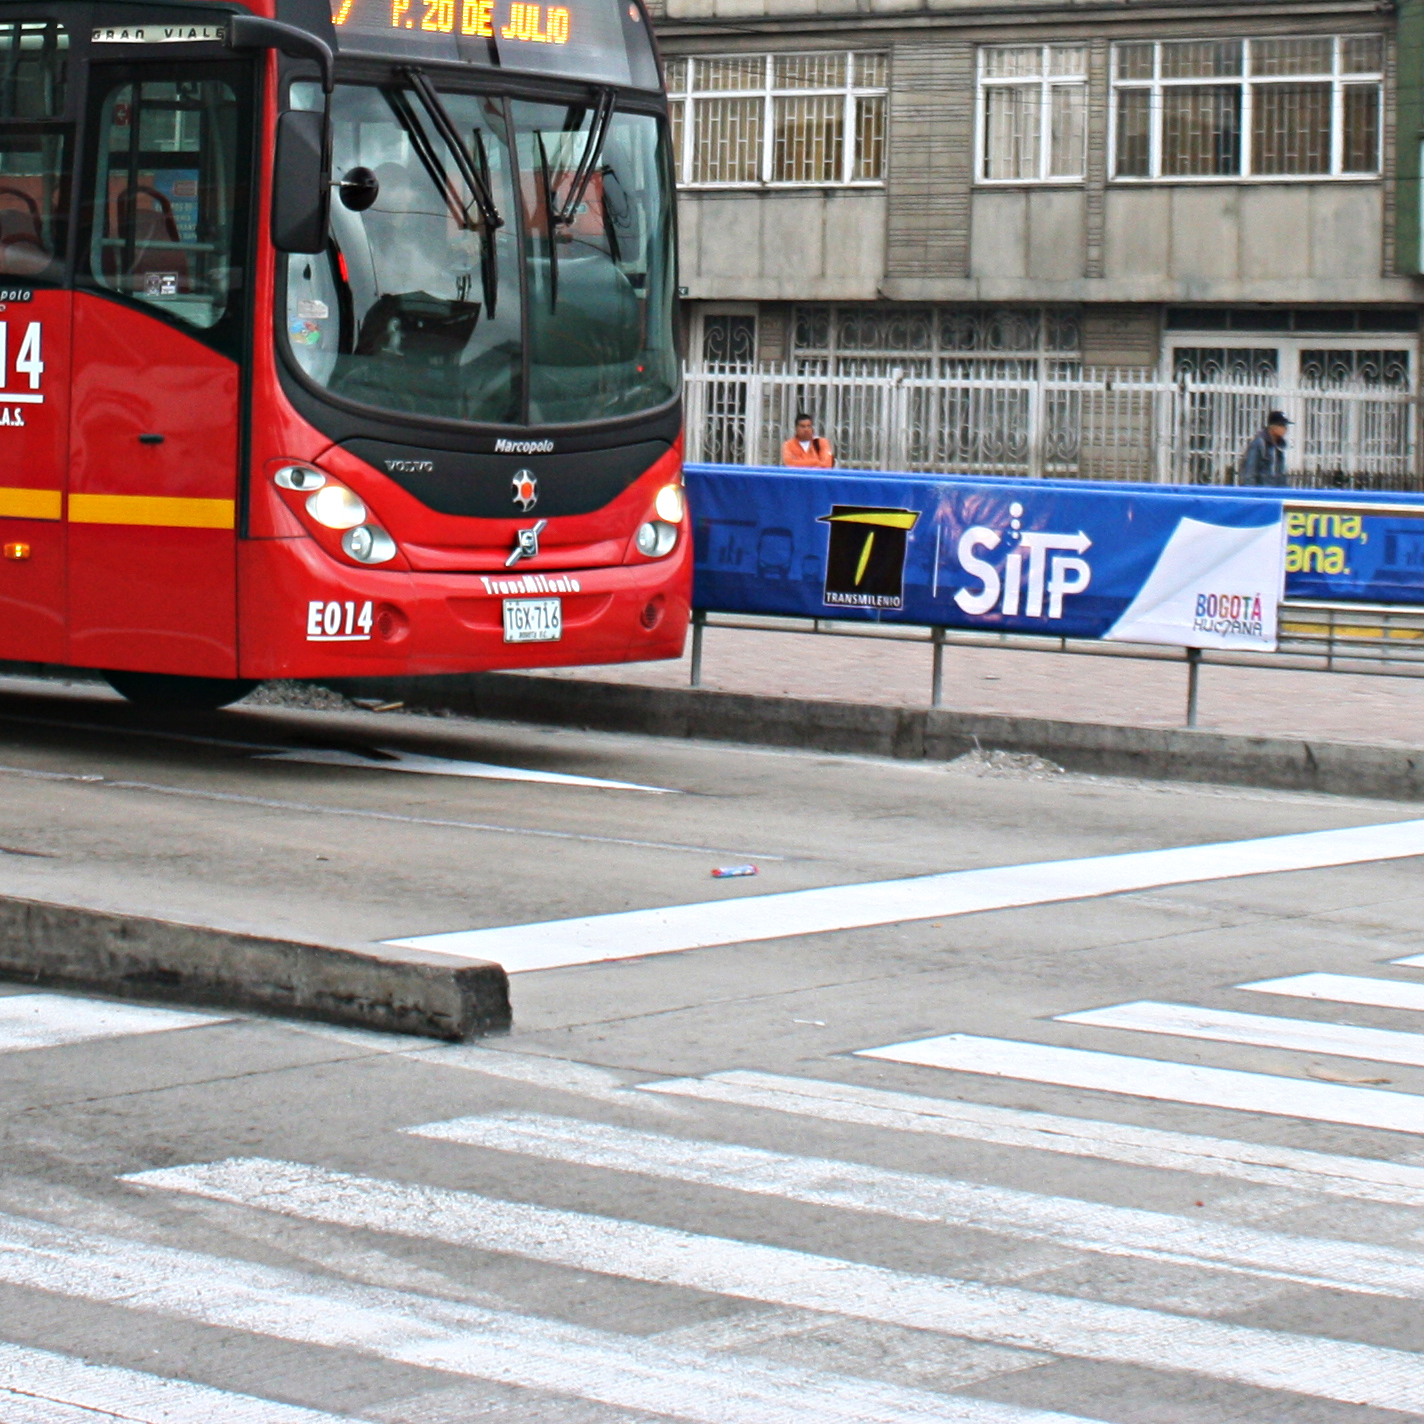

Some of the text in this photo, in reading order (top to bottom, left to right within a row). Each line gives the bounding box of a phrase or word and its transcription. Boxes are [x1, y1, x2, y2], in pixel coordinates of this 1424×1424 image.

[500, 1, 570, 46] JULIO
[92, 29, 145, 41] GRAN
[494, 438, 555, 455] Marcopolo
[384, 460, 434, 473] VOLVO
[480, 574, 581, 595] TransMilenio
[825, 592, 902, 608] TRANSMILENIO
[1196, 592, 1262, 622] BOGOTÁ
[306, 600, 374, 636] E014
